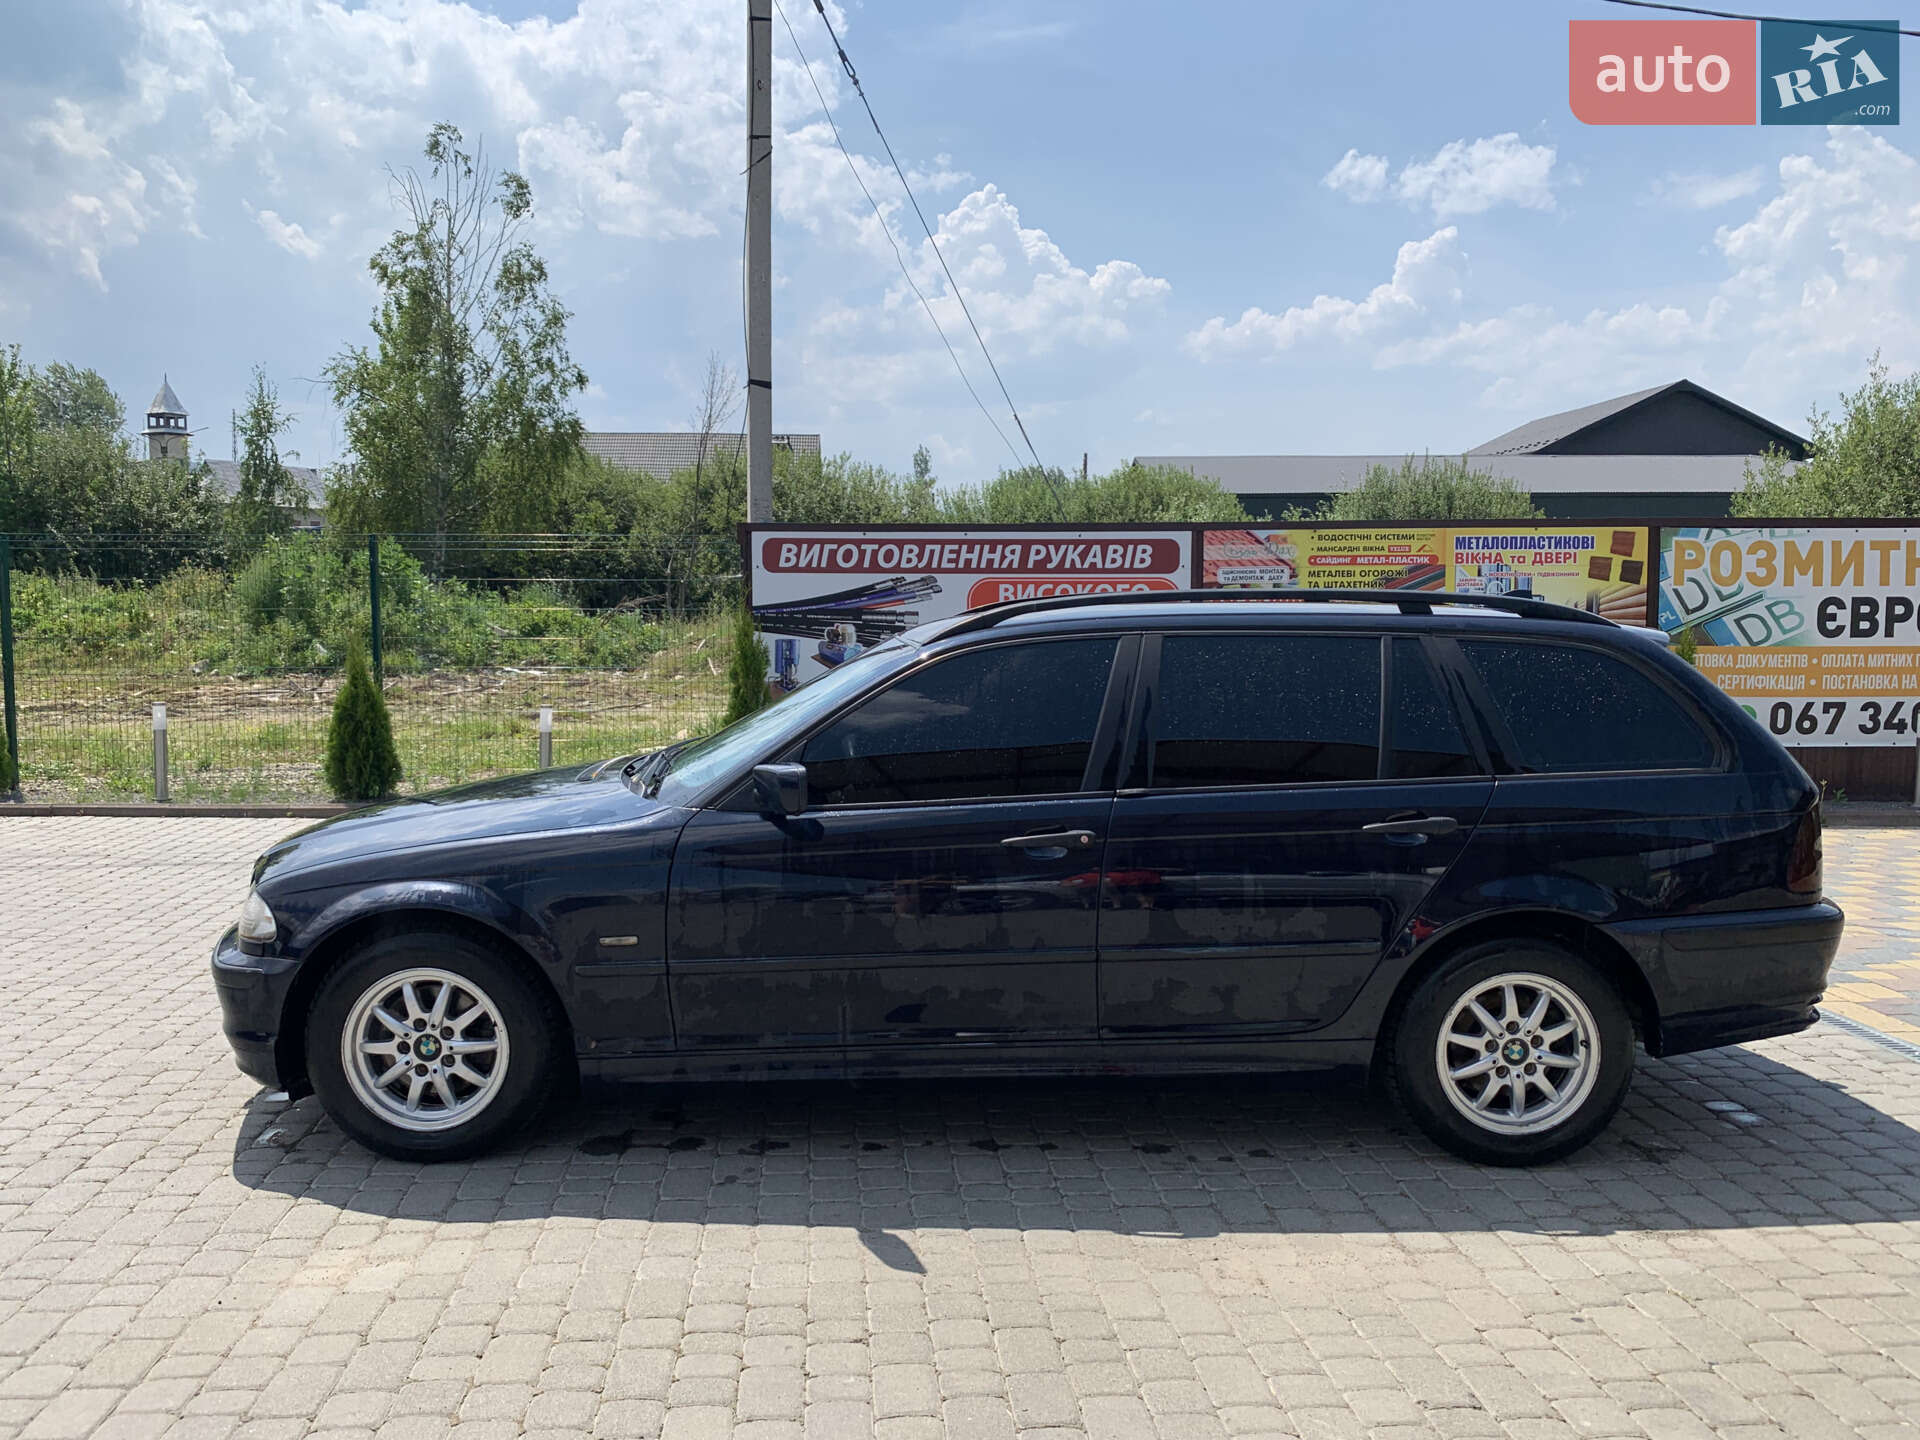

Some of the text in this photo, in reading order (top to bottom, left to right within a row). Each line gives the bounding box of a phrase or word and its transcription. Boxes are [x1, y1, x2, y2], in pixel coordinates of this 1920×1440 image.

[1317, 534, 1372, 542] ВОДОСТІЧНІ
[1374, 533, 1415, 541] СИСТЕМИ
[1455, 535, 1595, 550] МЕТАЛОПЛАСТИКОВІ
[778, 543, 1153, 569] ВИГОТОВЛЕННЯ РУКАВІВ
[1356, 556, 1430, 564] МЕТАЛ-ПЛАСТИК
[1454, 552, 1577, 566] ВІКНА та ДВЕРІ
[1307, 569, 1408, 578] МЕТАЛЕВІ ОГОРОЖІ
[1307, 580, 1386, 589] ТА ШТАХЕТНИК
[1816, 596, 1920, 639] ЄВР
[1735, 654, 1809, 669] ДОКУМЕНТІВ
[1821, 653, 1865, 667] ОПЛАТА
[1867, 653, 1913, 667] МИТНИХ
[1717, 674, 1918, 691] СЕРТИФІКАЦІЯ ПОСТАНОВКА НА
[1769, 701, 1847, 735] 067
